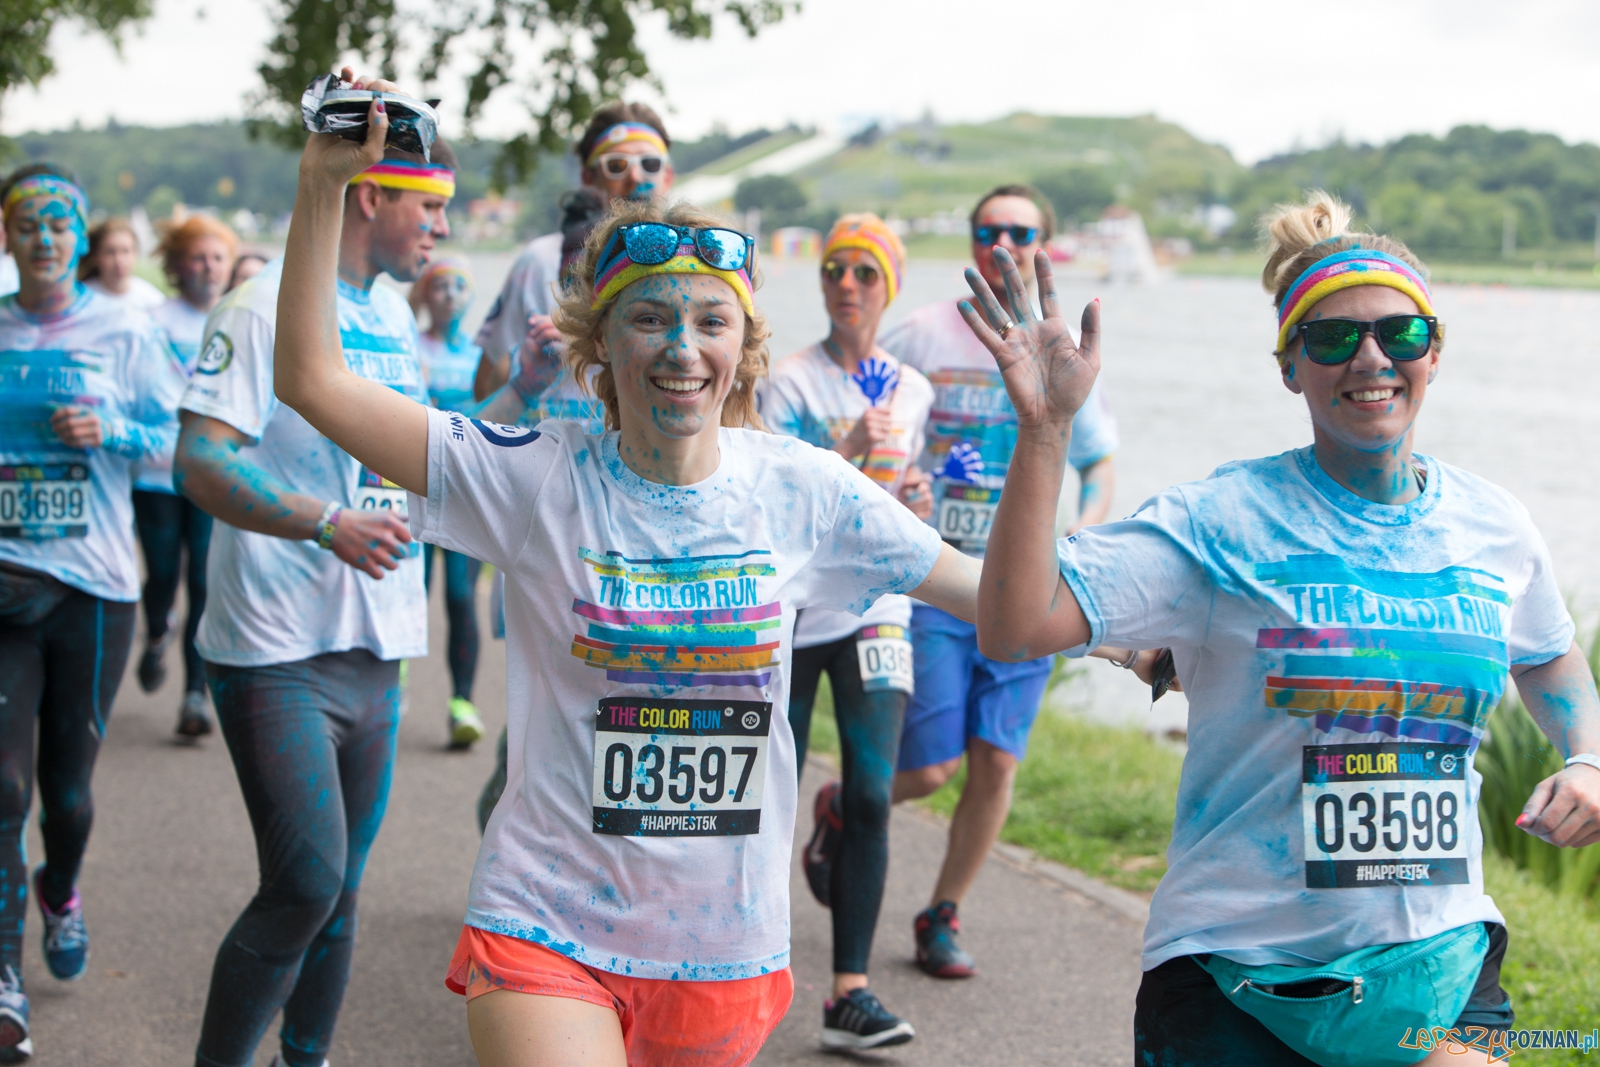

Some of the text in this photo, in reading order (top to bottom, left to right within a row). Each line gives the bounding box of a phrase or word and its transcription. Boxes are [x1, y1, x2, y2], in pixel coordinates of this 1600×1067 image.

[1, 488, 83, 521] 03699
[945, 505, 991, 536] 037
[599, 575, 632, 608] THE
[635, 582, 711, 608] COLOR
[1287, 585, 1502, 638] THE COLOR RUN
[866, 645, 909, 674] 036
[609, 705, 638, 727] THE
[639, 707, 690, 729] COLOR
[603, 742, 758, 804] 03597
[1314, 754, 1344, 775] THE
[1345, 753, 1398, 775] COLOR
[640, 815, 718, 831] #HAPPIEST5K
[1315, 790, 1458, 854] 03598
[1356, 863, 1430, 881] #HAPPIEST5K
